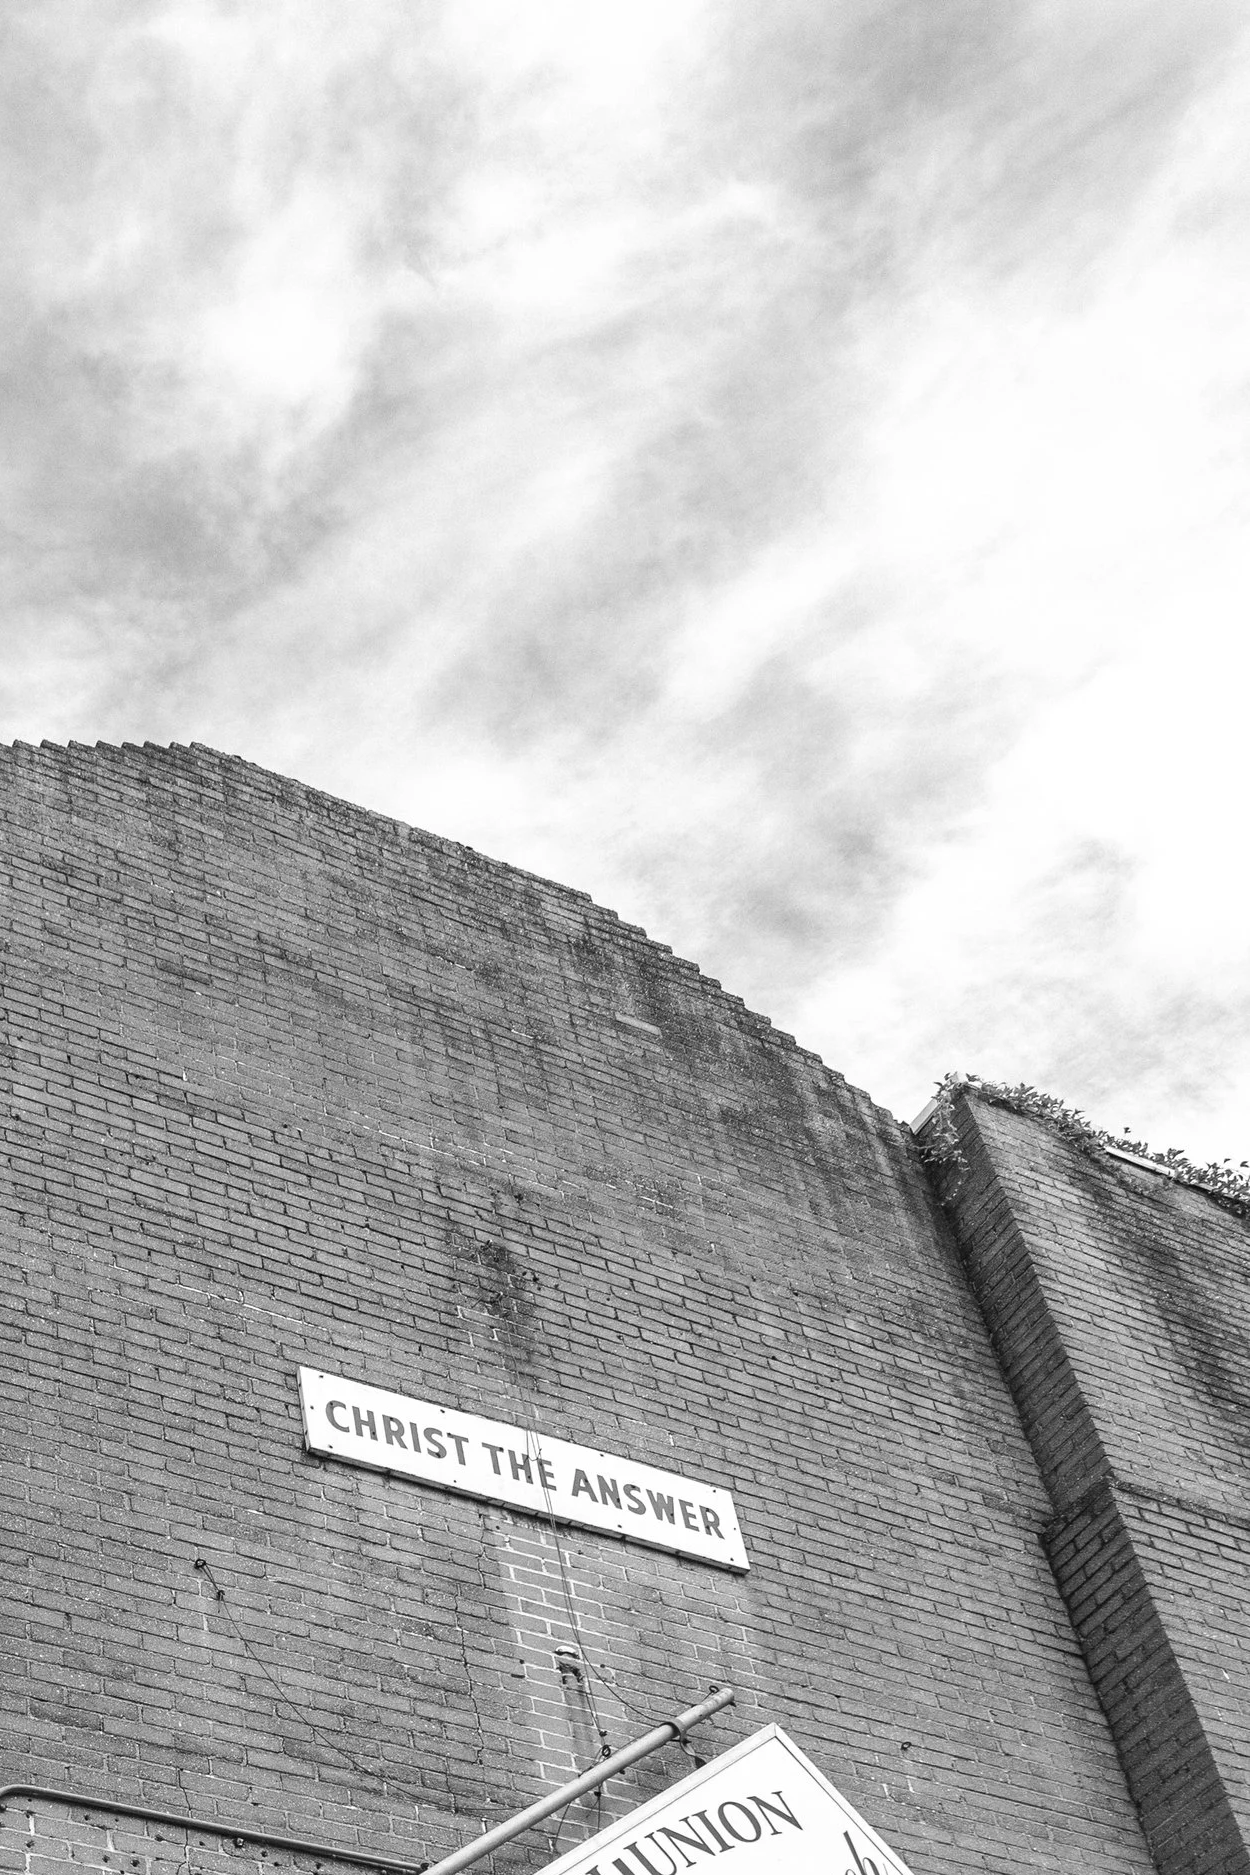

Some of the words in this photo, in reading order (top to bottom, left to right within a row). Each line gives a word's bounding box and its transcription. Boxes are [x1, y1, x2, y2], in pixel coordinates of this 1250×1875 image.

[325, 1400, 470, 1466] CHRIST
[482, 1442, 557, 1492] THE
[571, 1468, 725, 1540] ANSWER
